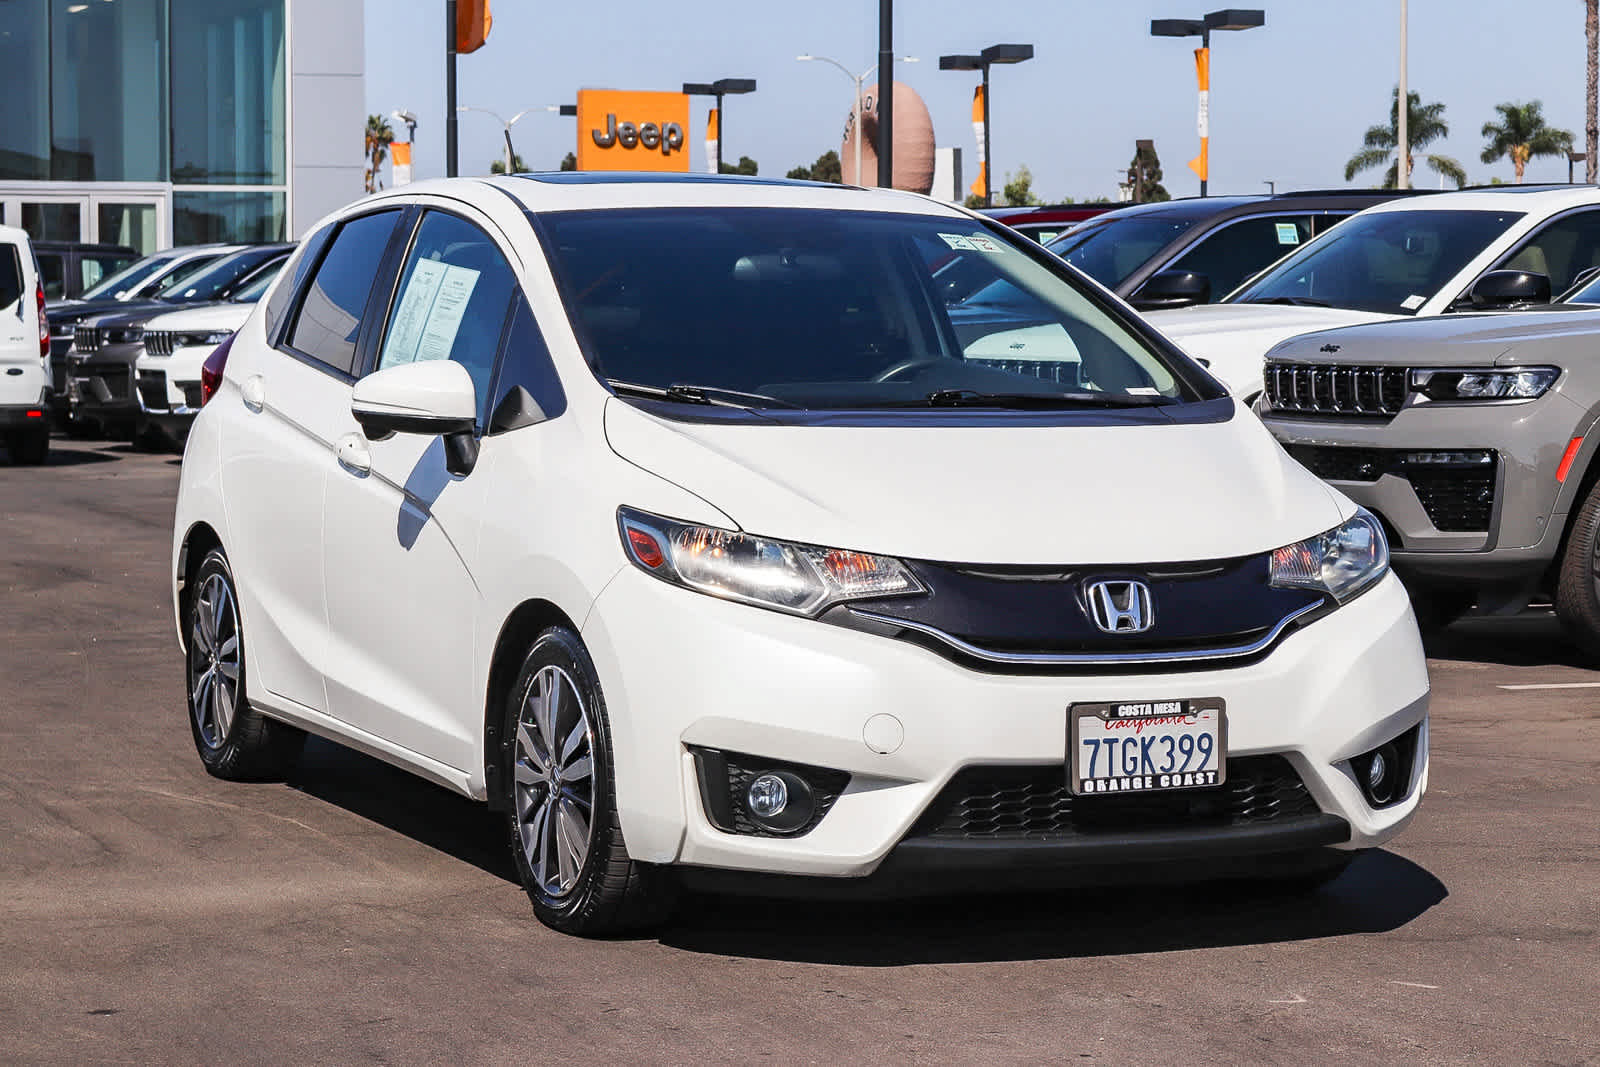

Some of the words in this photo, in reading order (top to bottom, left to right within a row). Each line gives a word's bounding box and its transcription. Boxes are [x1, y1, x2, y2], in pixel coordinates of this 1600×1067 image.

[592, 113, 684, 155] Jeep
[1118, 703, 1152, 717] COSTA
[1153, 702, 1181, 714] MESA
[1083, 733, 1213, 777] 7TGK399
[1084, 777, 1153, 792] ORANGE
[1160, 772, 1215, 787] COAST
